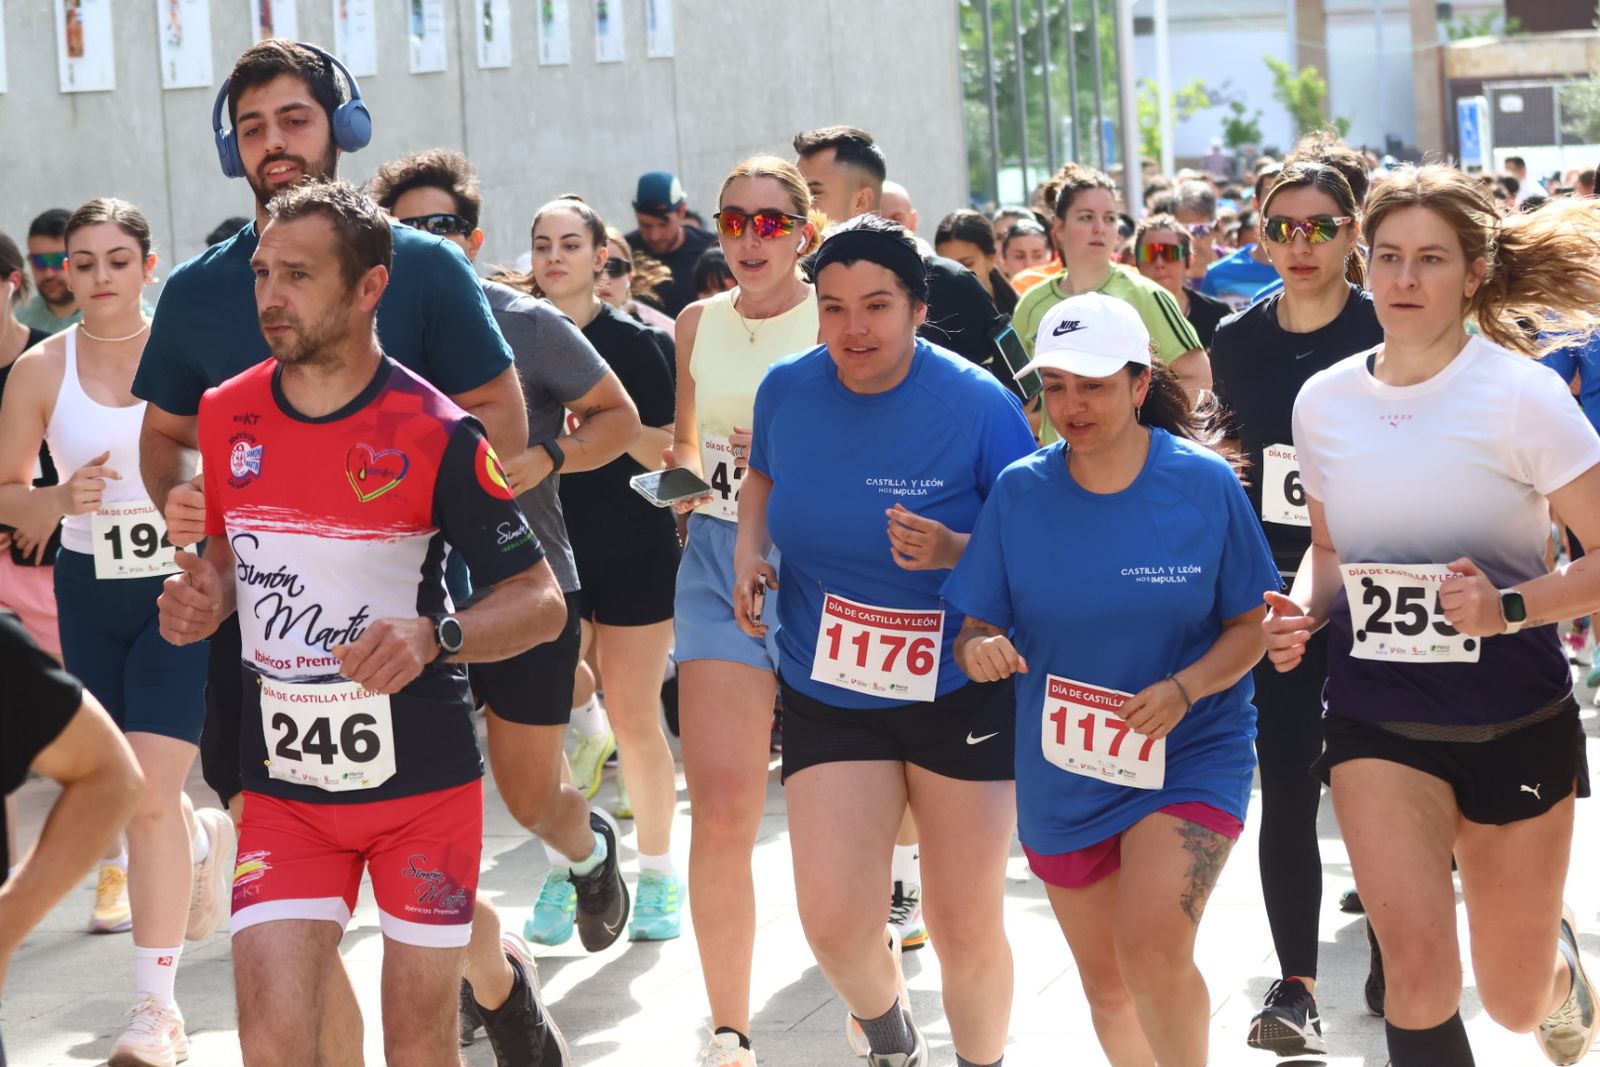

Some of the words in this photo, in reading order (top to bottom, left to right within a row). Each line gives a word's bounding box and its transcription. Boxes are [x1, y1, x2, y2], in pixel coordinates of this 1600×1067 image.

[1059, 320, 1080, 329] NIKE
[716, 444, 725, 452] DE
[1268, 449, 1281, 458] DÍA
[865, 478, 907, 487] CASTILLA
[911, 480, 918, 488] Y
[920, 478, 944, 488] LEÓN
[231, 533, 305, 598] Simón
[1121, 566, 1165, 576] CASTILLA
[1168, 566, 1175, 575] Y
[1177, 564, 1202, 574] LEÓN
[1384, 568, 1428, 582] CASTILLA
[828, 601, 843, 613] DÍA
[844, 607, 857, 617] DE
[858, 611, 901, 625] CASTILLA
[904, 618, 911, 626] Y
[911, 617, 937, 627] LEÓN
[254, 592, 369, 652] Martí
[826, 623, 936, 676] 1176
[255, 650, 292, 670] Ibéricos
[296, 656, 342, 668] Premi
[263, 686, 276, 697] DÍA
[277, 691, 288, 702] DE
[289, 694, 338, 704] CASTILLA
[340, 692, 348, 702] Y
[1051, 684, 1068, 696] DÍA
[1069, 689, 1082, 699] DE
[272, 712, 381, 765] 246
[404, 904, 432, 914] Ibéricos
[433, 907, 460, 916] Premium
